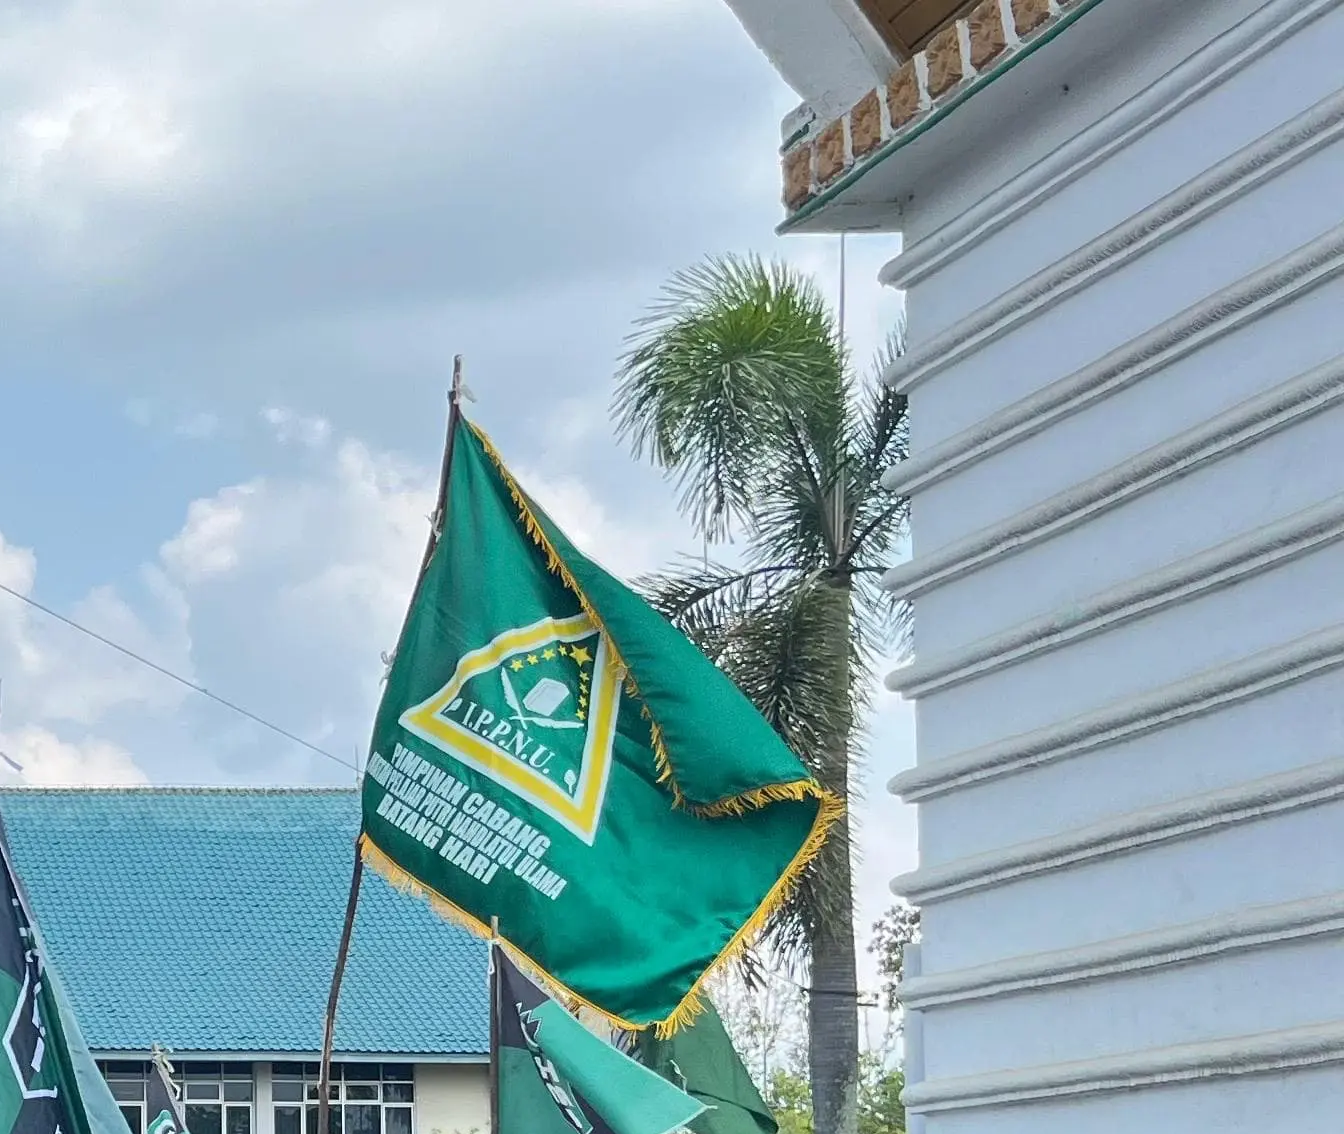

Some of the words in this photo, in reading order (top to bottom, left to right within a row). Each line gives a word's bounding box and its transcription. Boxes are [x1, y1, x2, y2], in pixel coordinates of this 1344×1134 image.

[375, 793, 445, 851] BATANG
[438, 835, 501, 886] HARI
[390, 742, 471, 807] PIMPINAN
[462, 792, 552, 861] CABANG
[514, 854, 569, 901] ULAMA
